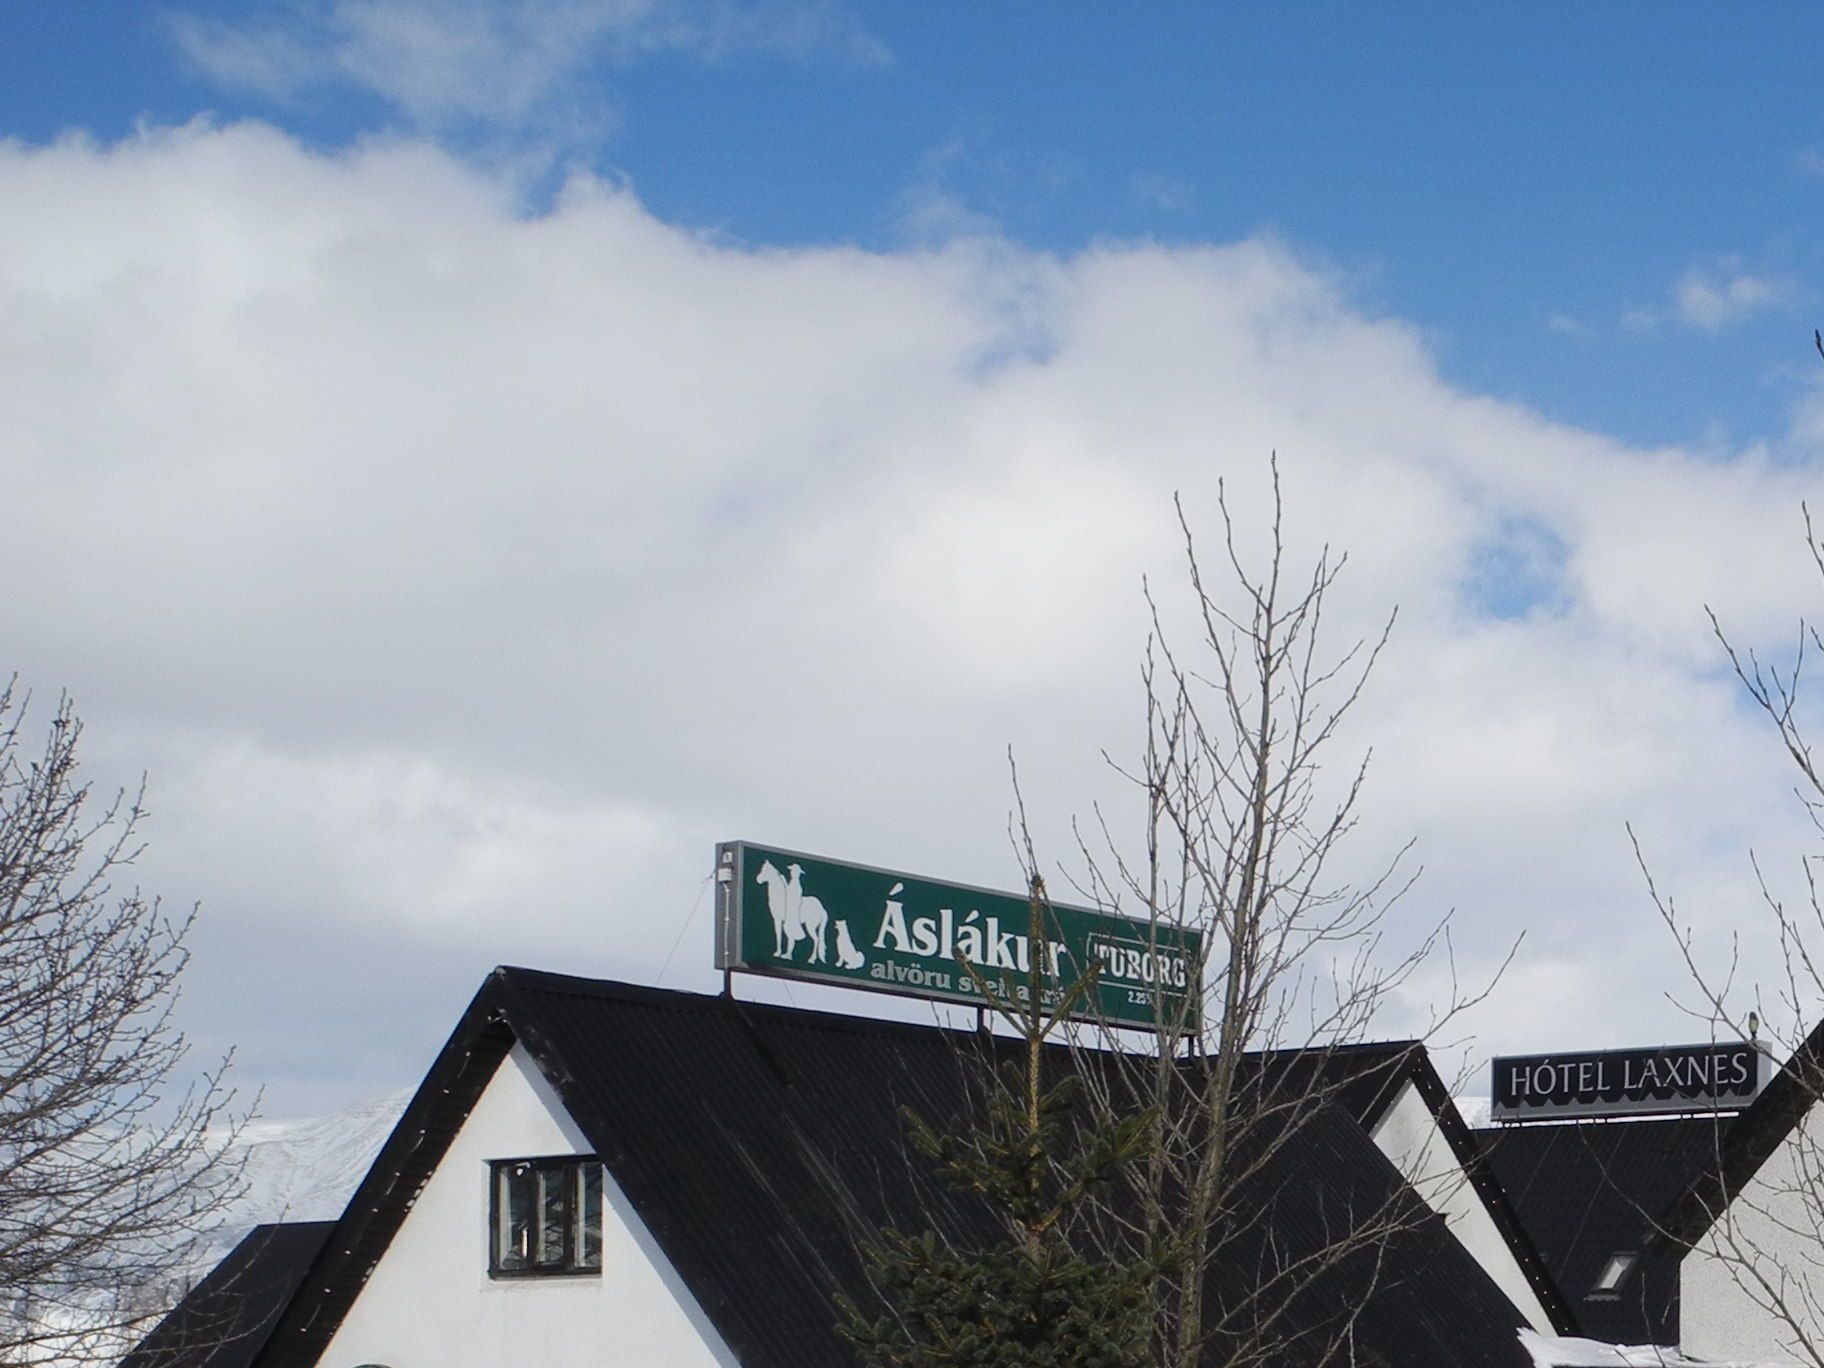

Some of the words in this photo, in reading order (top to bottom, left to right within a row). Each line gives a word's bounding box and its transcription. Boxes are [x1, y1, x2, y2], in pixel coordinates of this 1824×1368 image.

[873, 882, 1066, 977] Áslákur
[870, 959, 951, 989] alvöru
[1093, 943, 1187, 988] TUBORG
[1510, 1059, 1610, 1096] HÓTEL
[1623, 1052, 1748, 1089] LAXNES
